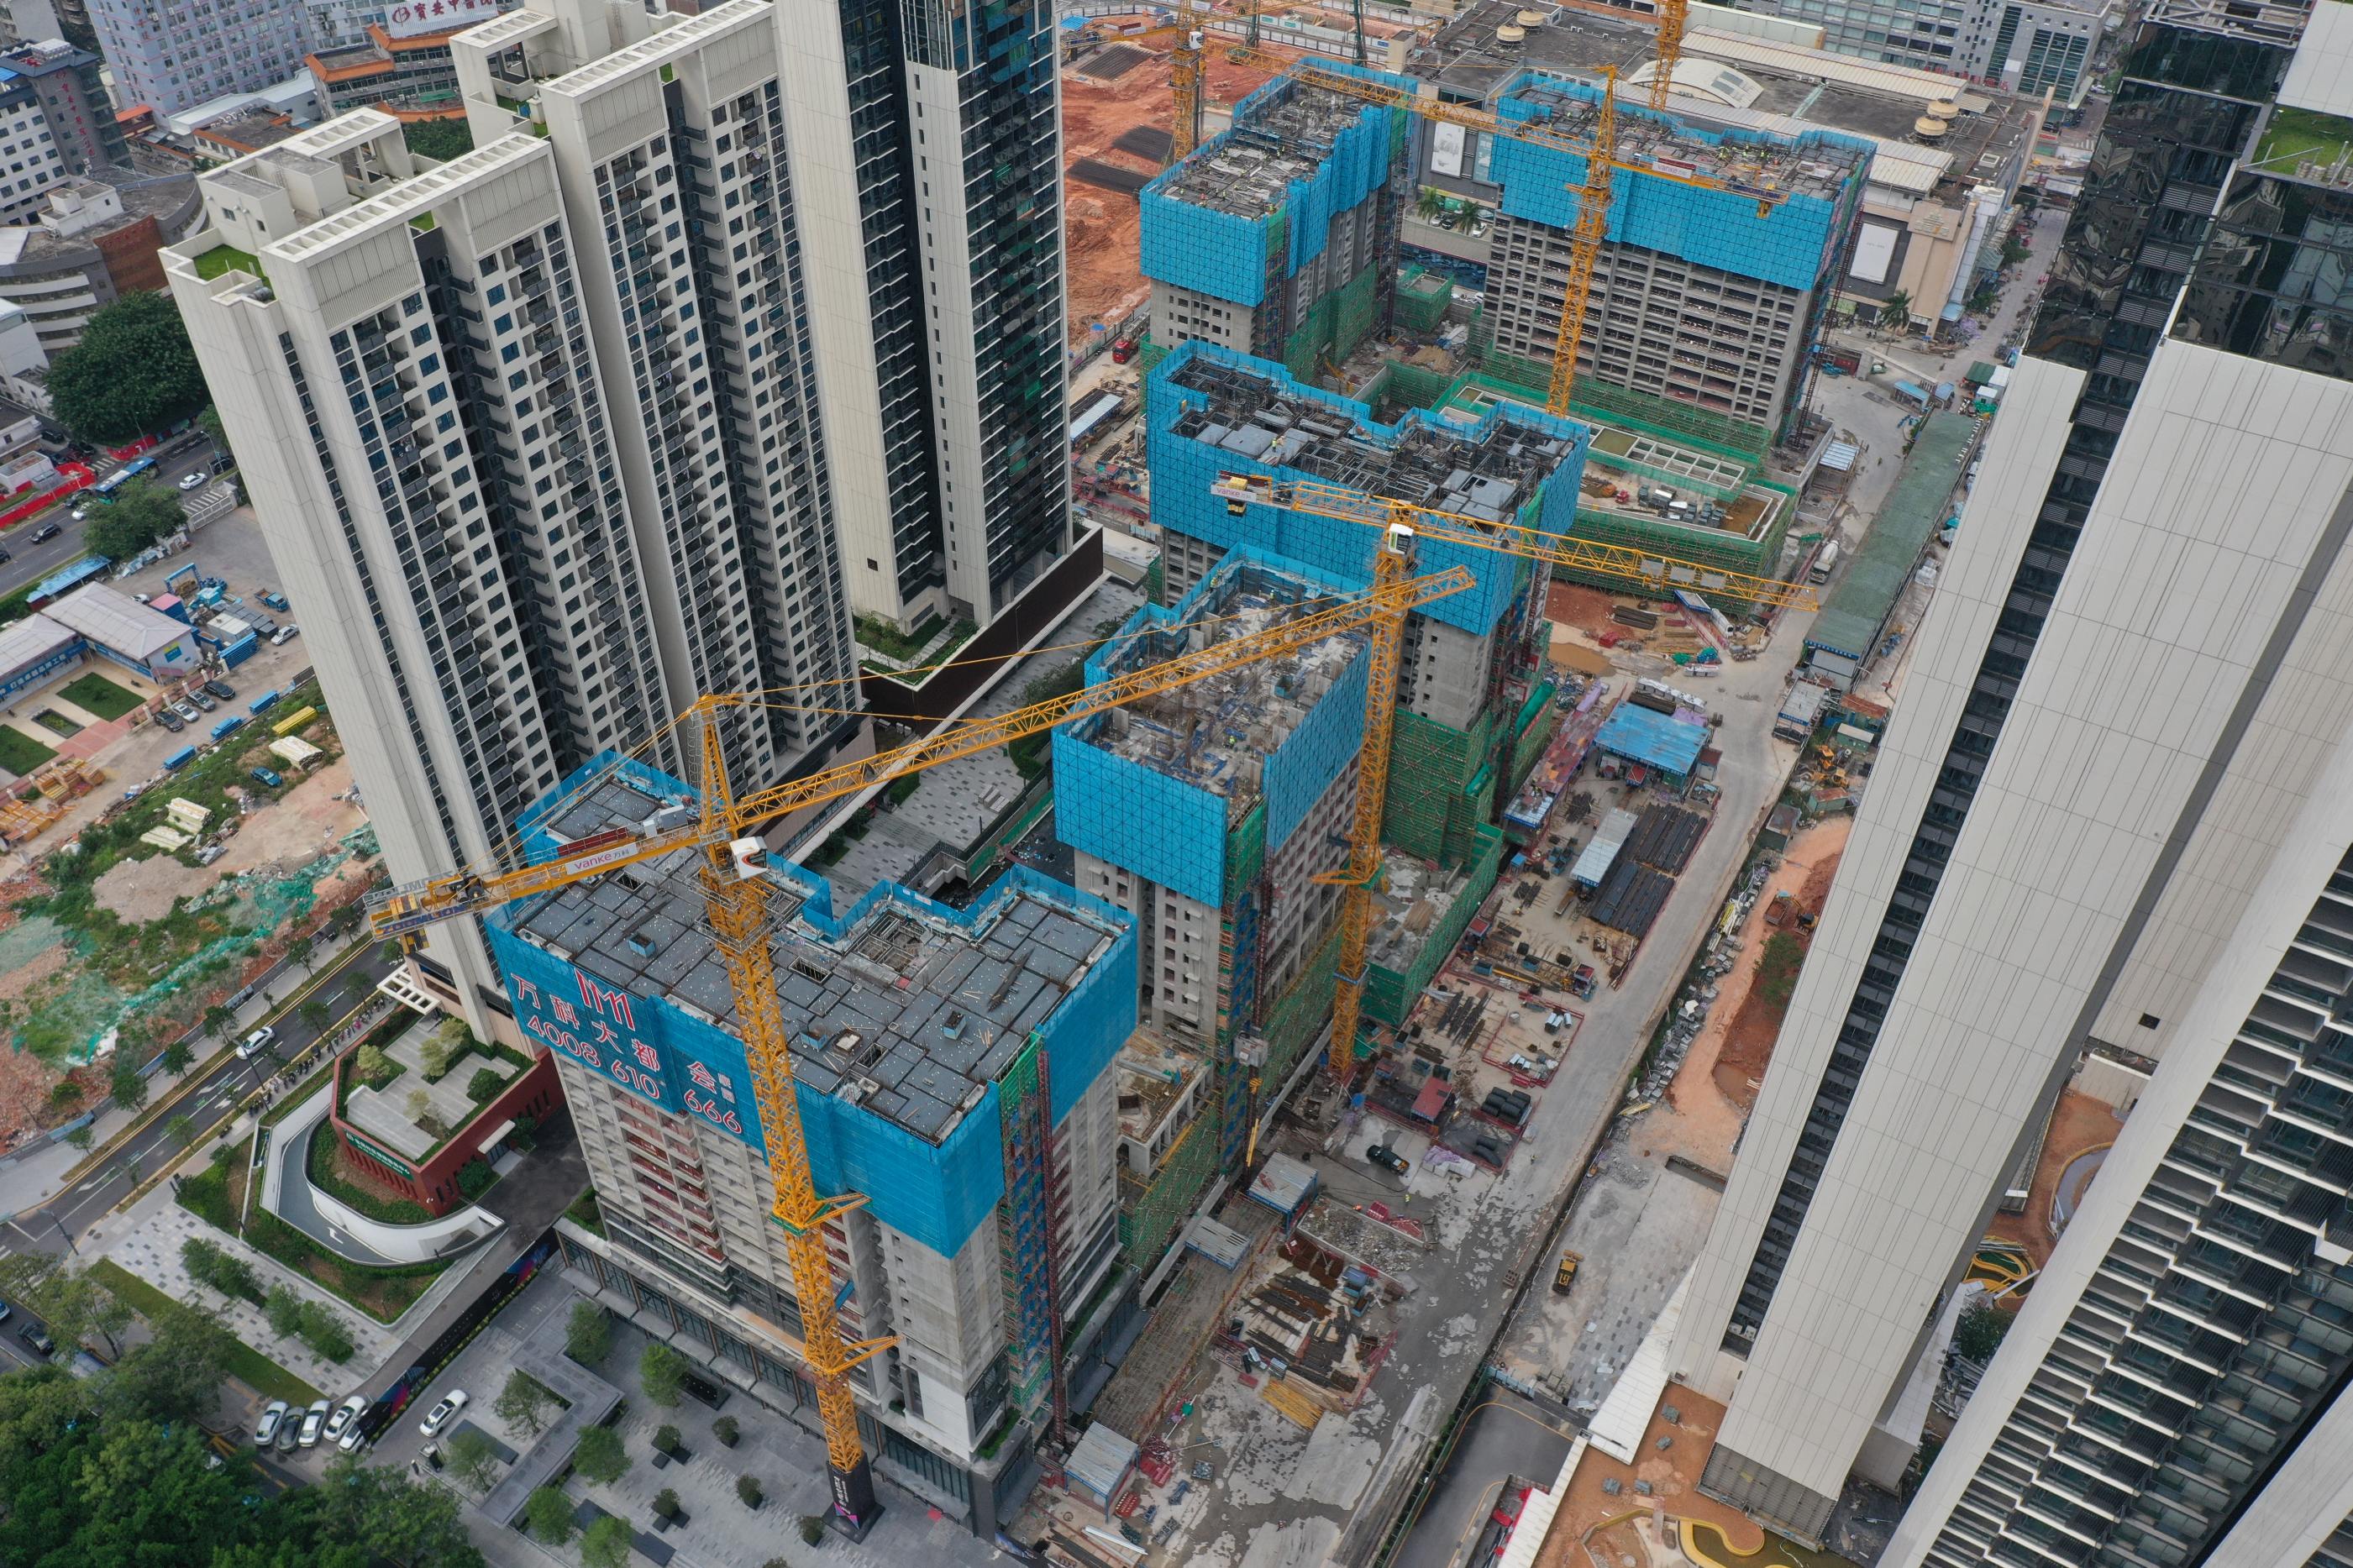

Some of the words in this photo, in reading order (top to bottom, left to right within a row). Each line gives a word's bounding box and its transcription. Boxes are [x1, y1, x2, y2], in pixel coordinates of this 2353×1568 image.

[528, 1015, 601, 1067] 4008
[611, 1060, 660, 1099] 610
[684, 1088, 742, 1134] 666
